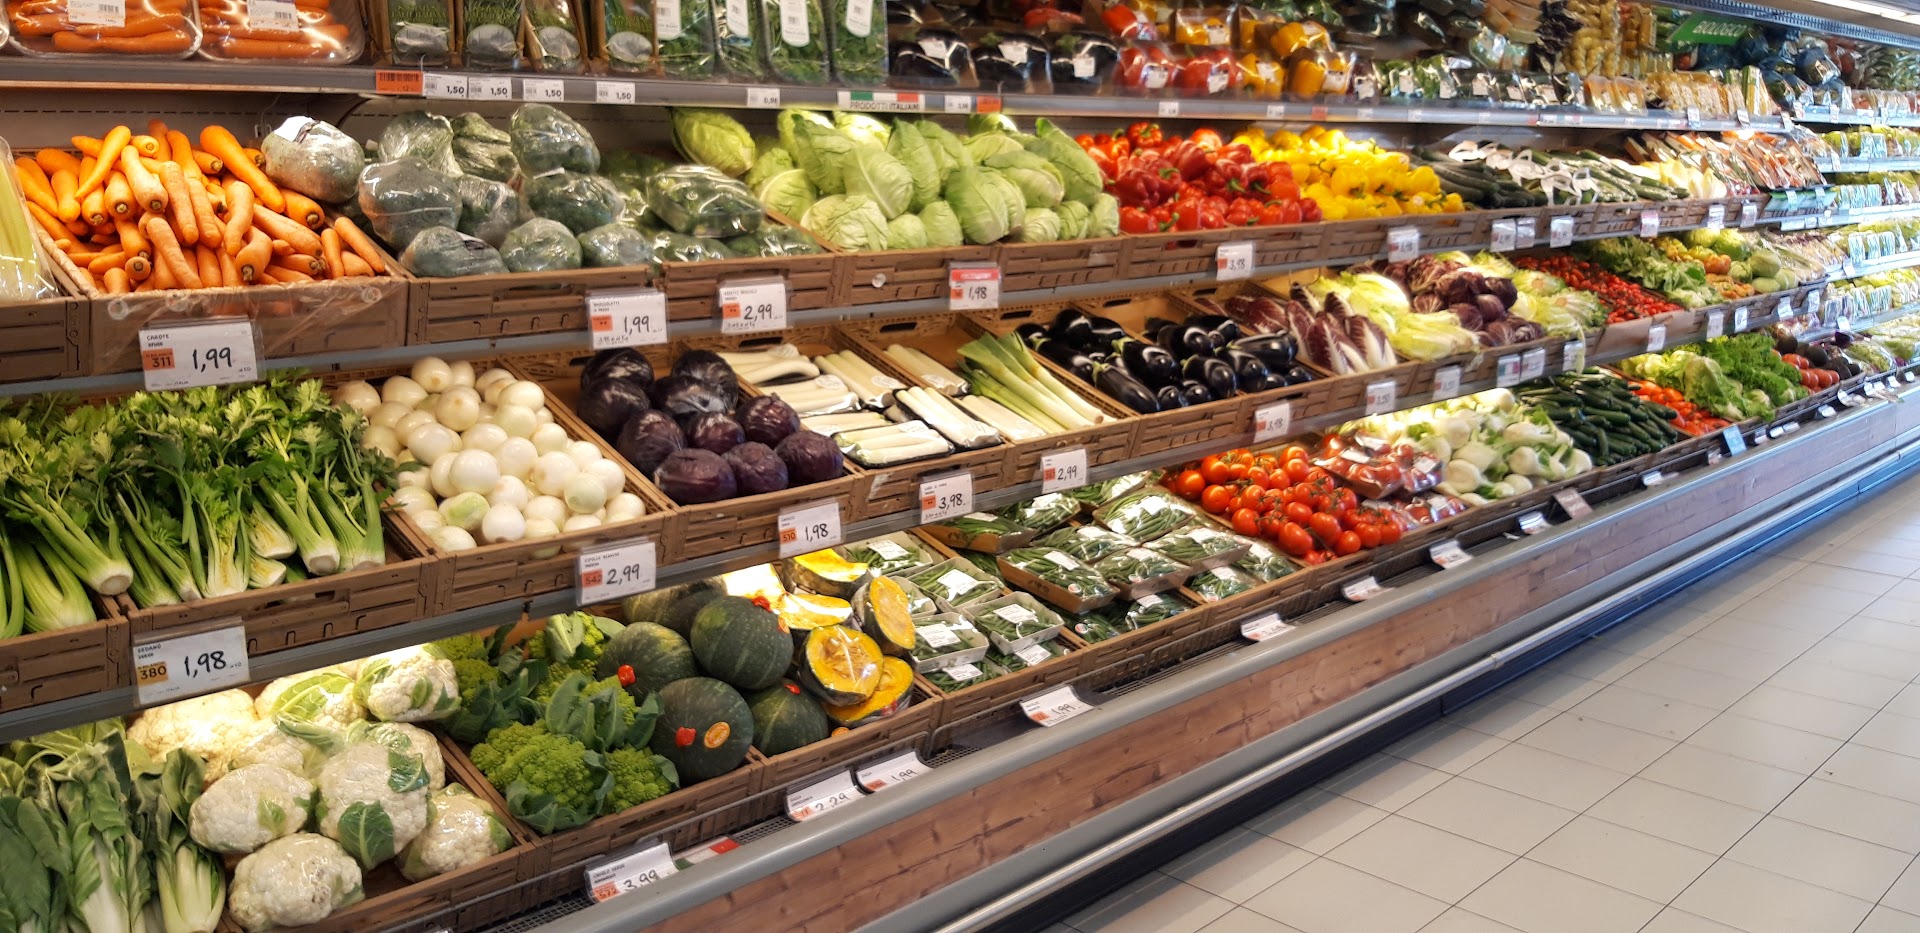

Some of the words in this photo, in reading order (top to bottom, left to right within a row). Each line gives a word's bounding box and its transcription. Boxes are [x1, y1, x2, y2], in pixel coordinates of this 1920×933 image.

[1692, 20, 1747, 37] BIOLOGICO
[446, 85, 464, 94] 1,50
[490, 87, 508, 96] 1,50
[545, 89, 562, 98] 1,50
[616, 92, 632, 100] 1,50
[850, 101, 888, 110] PRODOTTI
[968, 286, 987, 300] 1,98
[744, 304, 772, 322] 2,99
[624, 316, 650, 335] 1,99
[152, 356, 172, 368] 311
[192, 346, 232, 372] 1,99
[1058, 465, 1077, 480] 2,99
[938, 494, 962, 510] 3,98
[783, 532, 796, 542] 510
[805, 523, 828, 542] 1,98
[586, 574, 602, 585] 542
[606, 564, 640, 585] 2,99
[184, 651, 226, 678] 1,98
[140, 666, 167, 680] 380
[1051, 703, 1076, 715] 1,99
[891, 769, 917, 781] 1,99
[623, 870, 658, 890] 399
